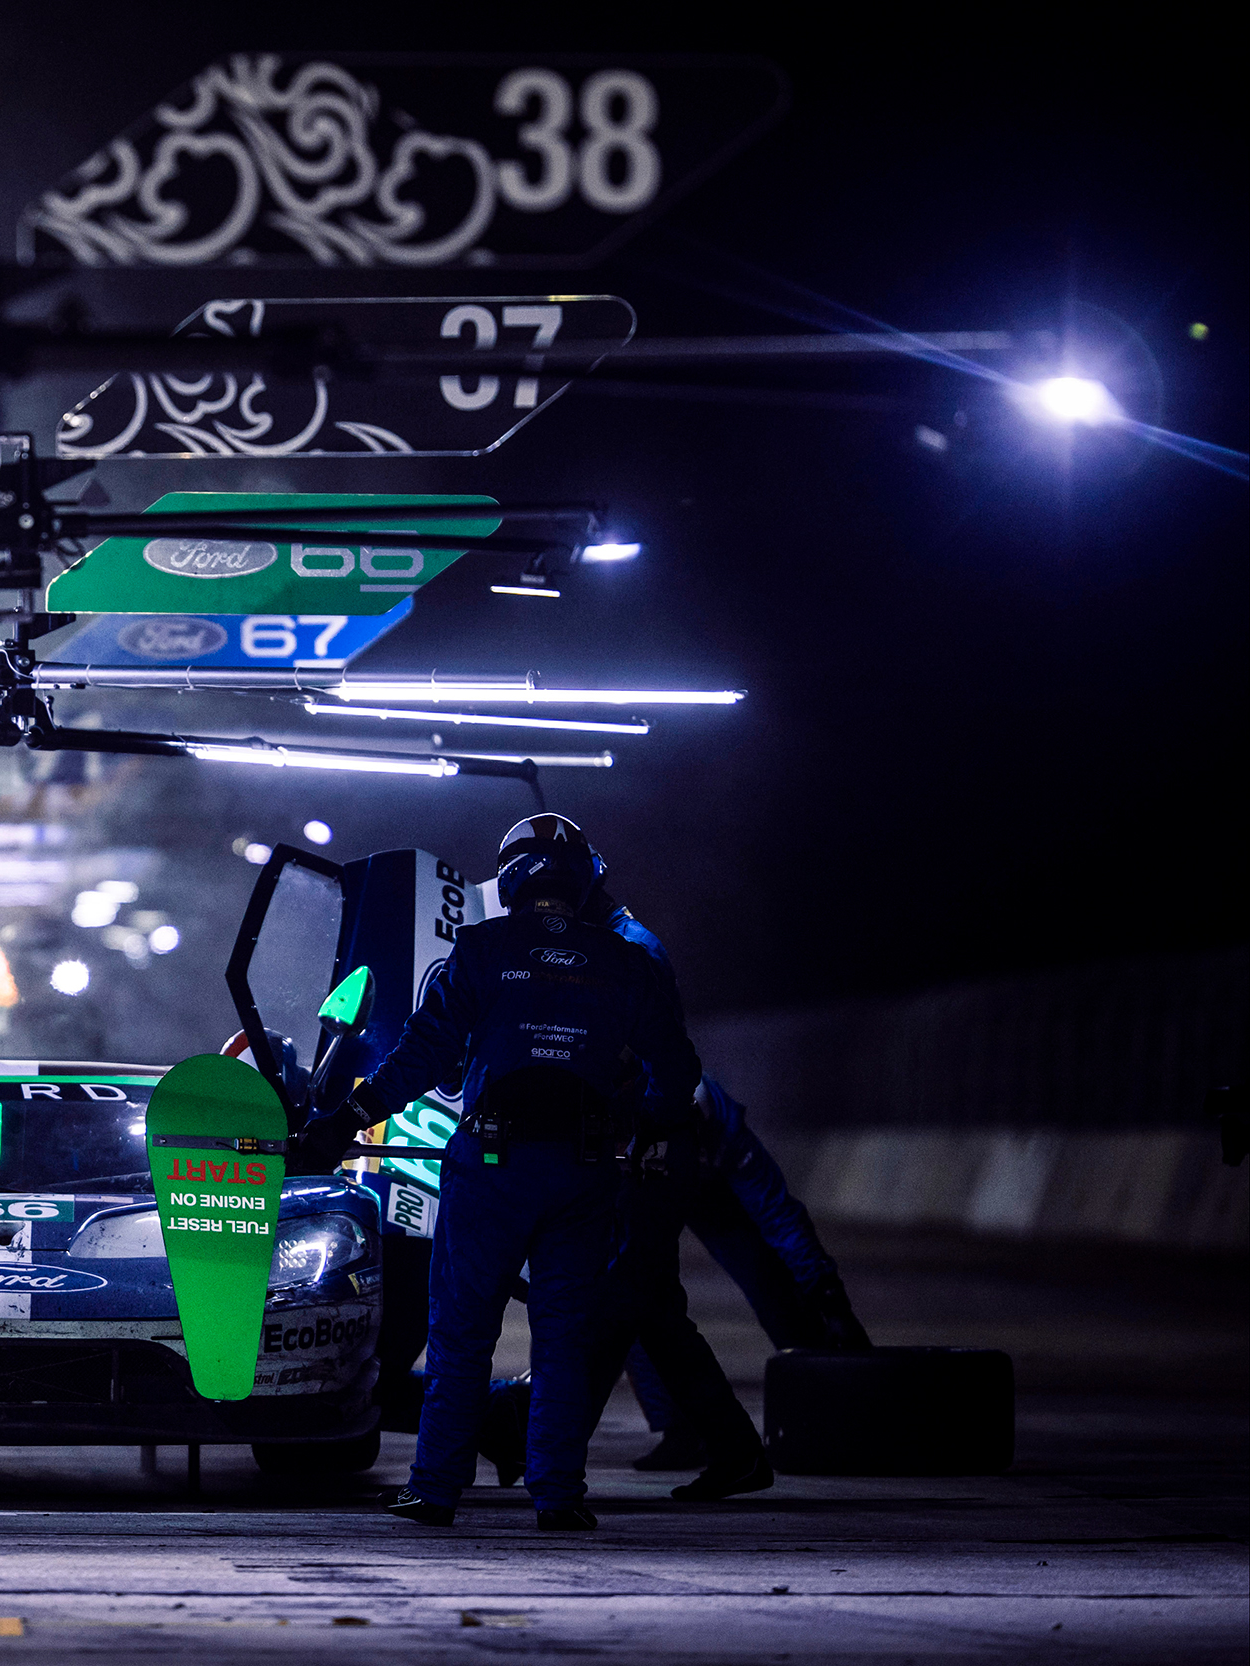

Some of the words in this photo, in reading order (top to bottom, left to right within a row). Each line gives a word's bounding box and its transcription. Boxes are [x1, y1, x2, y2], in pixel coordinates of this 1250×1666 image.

[492, 65, 662, 216] 38
[439, 304, 563, 411] 37
[290, 530, 424, 578] 66
[239, 615, 349, 659] 67
[540, 949, 577, 967] Ford
[501, 970, 532, 981] FORD
[166, 1158, 267, 1186] START
[170, 1192, 197, 1207] ON
[199, 1194, 266, 1211] ENGINE
[394, 1188, 425, 1232] PRO
[166, 1216, 223, 1233] RESET
[226, 1219, 270, 1235] FUEL
[253, 1372, 275, 1385] strol
